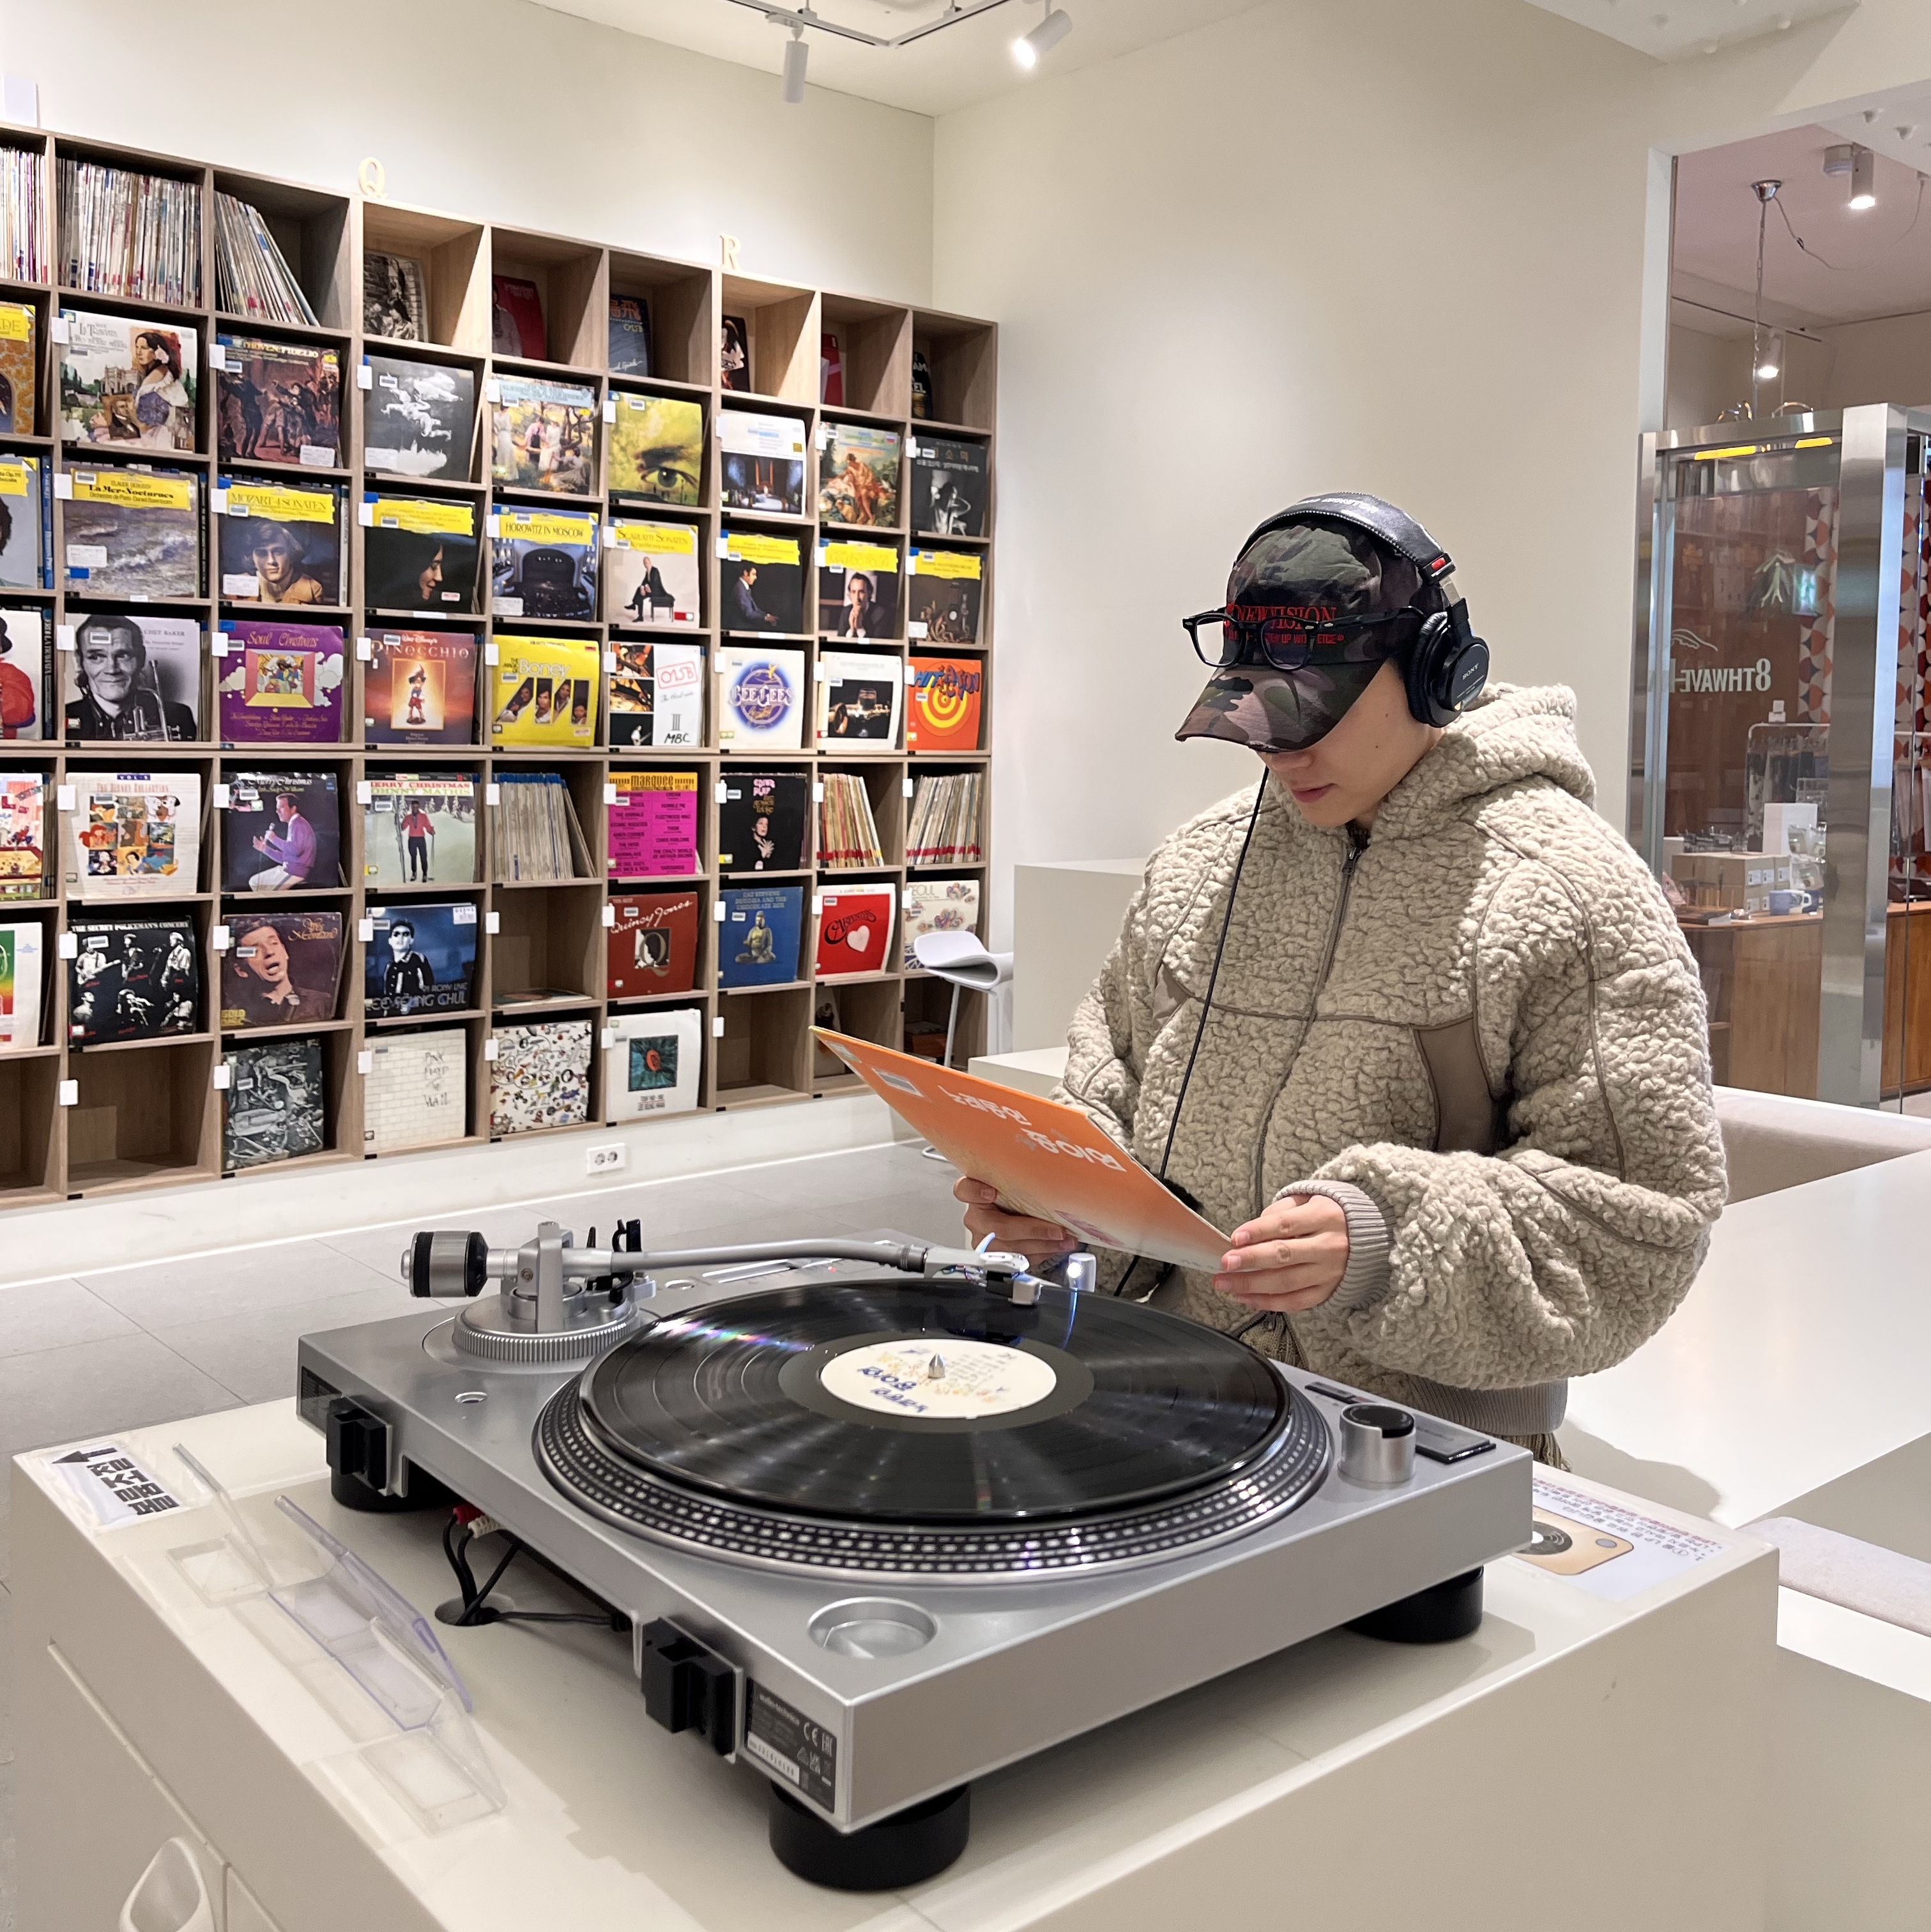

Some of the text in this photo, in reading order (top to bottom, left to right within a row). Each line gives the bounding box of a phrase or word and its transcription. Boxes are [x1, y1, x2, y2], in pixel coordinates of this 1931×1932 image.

[358, 156, 388, 199] Q
[720, 234, 742, 270] R
[231, 493, 271, 505] MOZART
[281, 499, 326, 510] SONATEN
[506, 522, 584, 537] HOROWITZ IN MOSCOW
[618, 529, 688, 544] SCARLATTI SONATEN
[247, 631, 318, 647] Soul Christmas
[371, 640, 469, 659] PINOCCHIO
[519, 658, 570, 681] Boney
[1462, 662, 1479, 680] SONY
[664, 733, 691, 744] MBC
[630, 775, 674, 787] marquee
[611, 900, 694, 934] Quincy Jones
[438, 991, 466, 1006] CHUL
